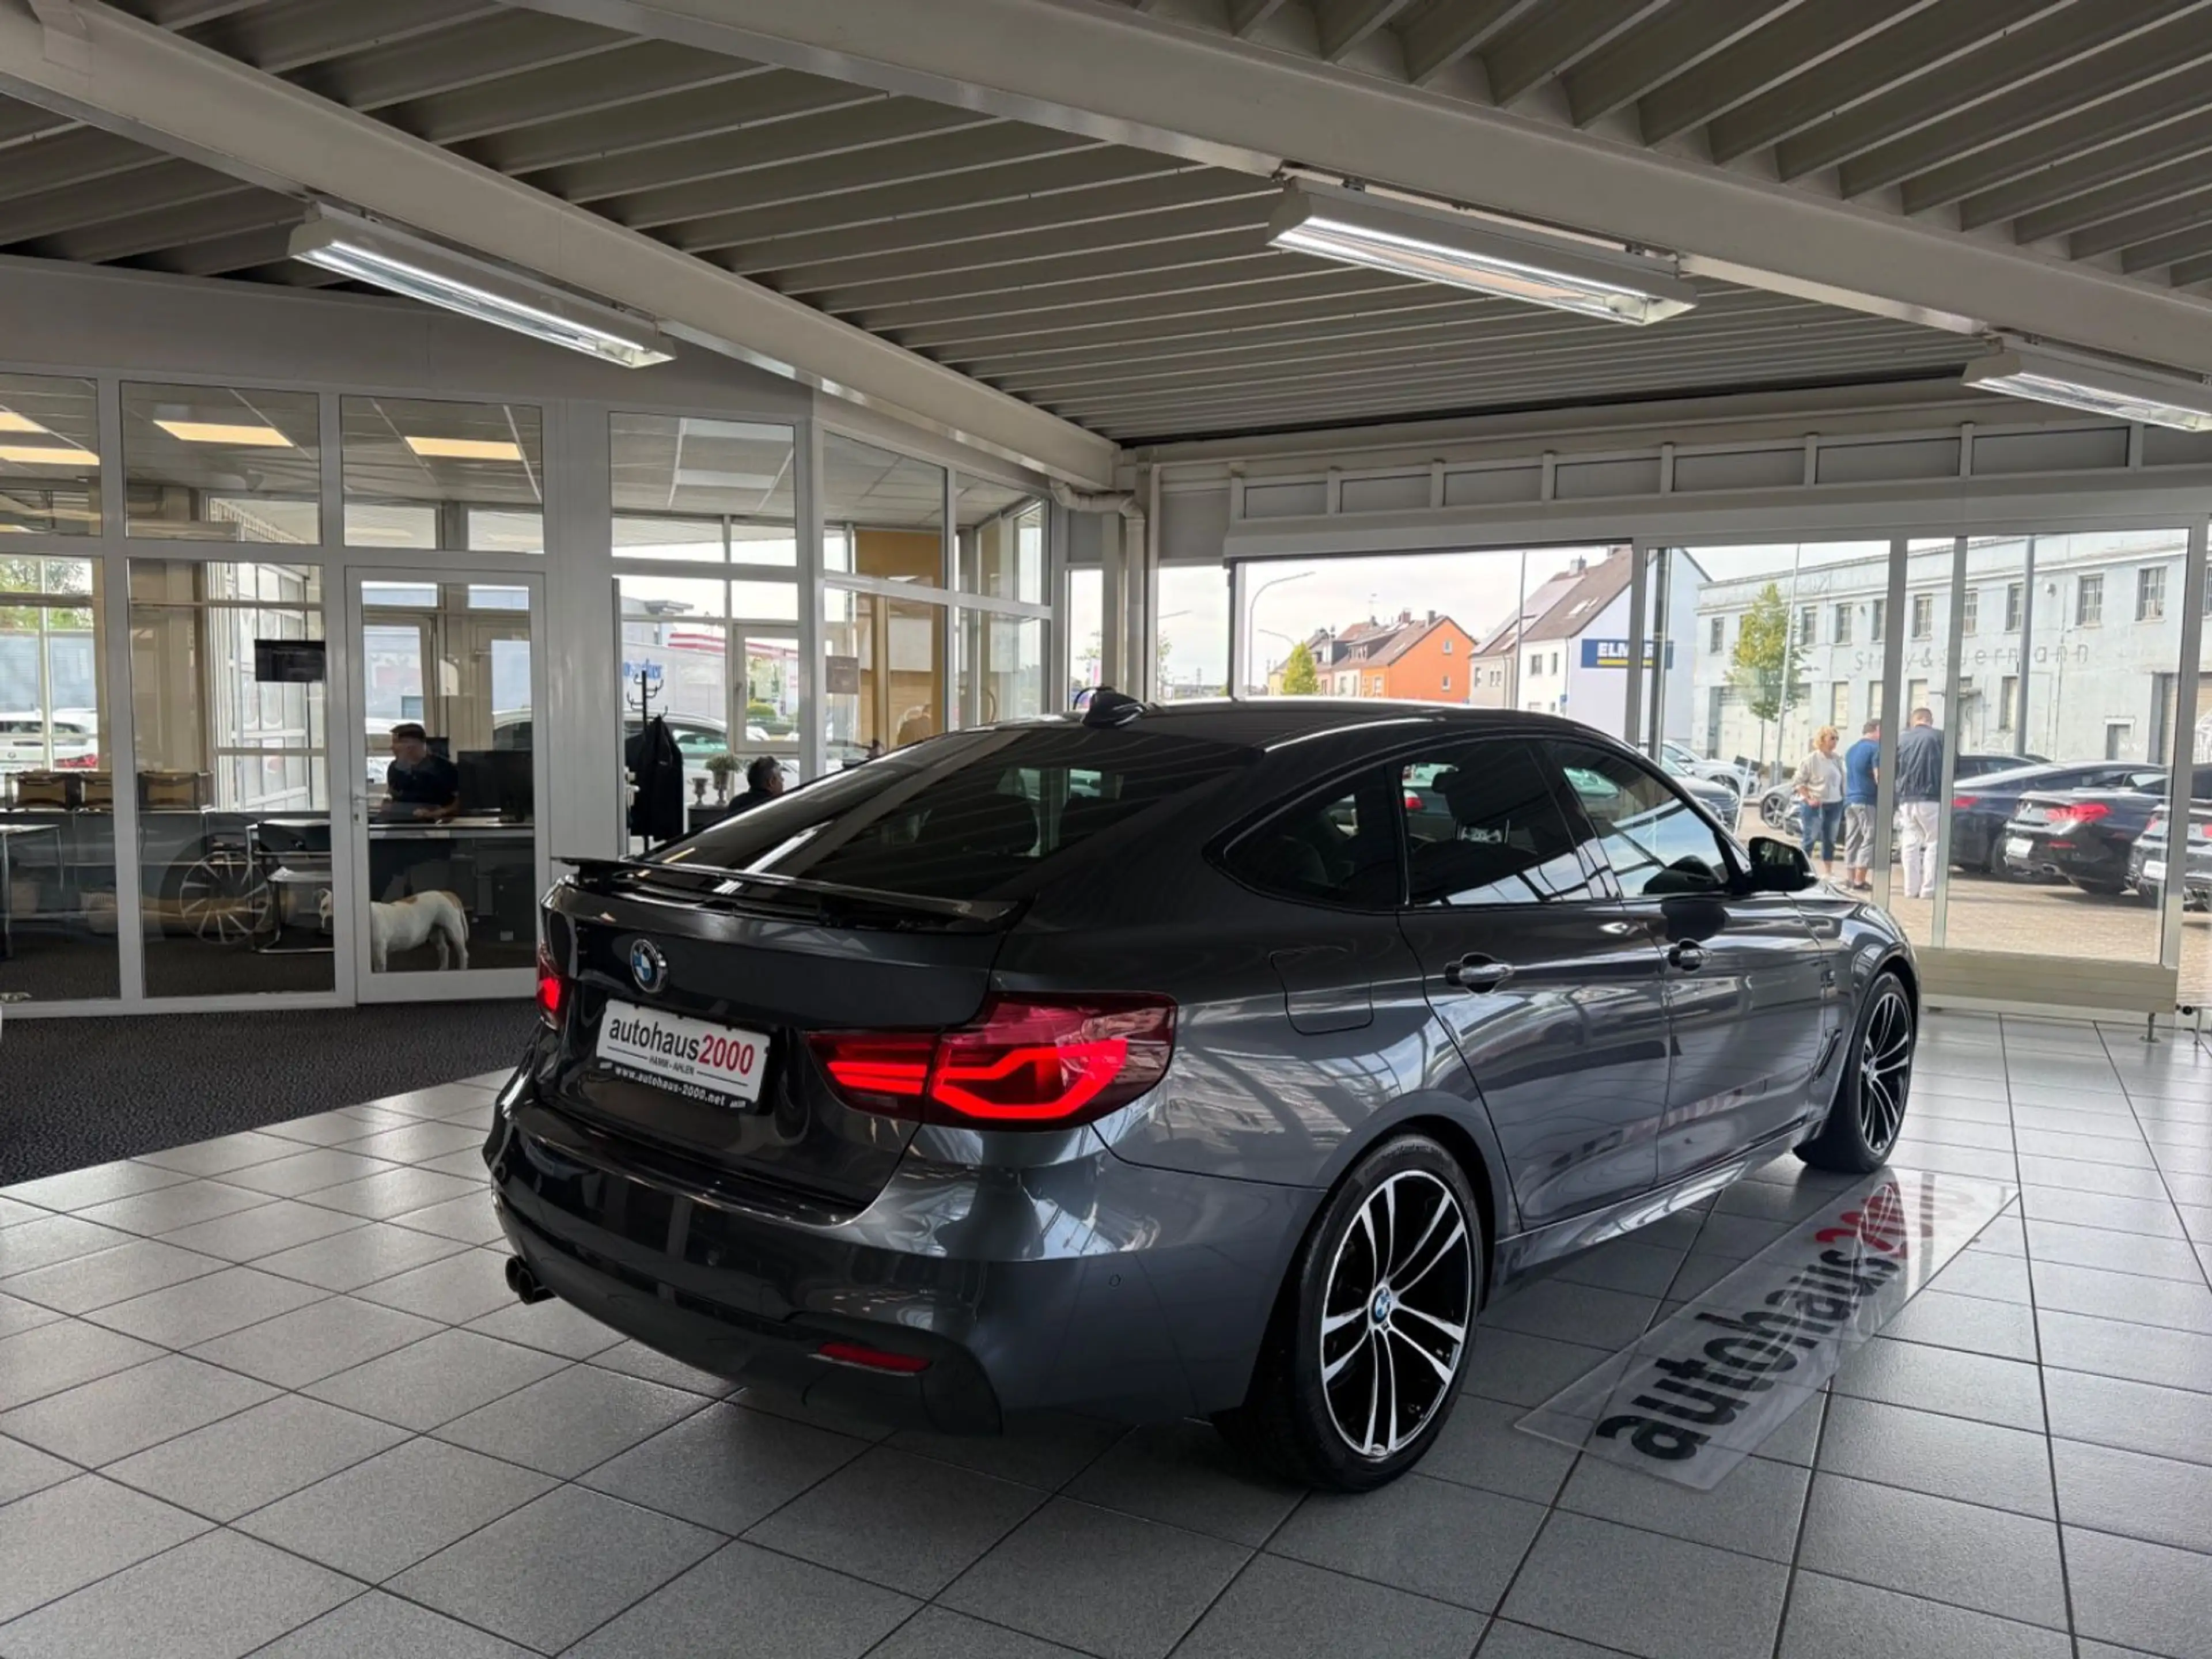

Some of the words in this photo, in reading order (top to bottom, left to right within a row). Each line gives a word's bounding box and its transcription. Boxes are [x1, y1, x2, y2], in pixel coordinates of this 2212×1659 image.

[1597, 641, 1653, 658] ELMR
[609, 1018, 754, 1075] autohaus2000
[615, 1066, 725, 1107] www.autohaus-2000.net
